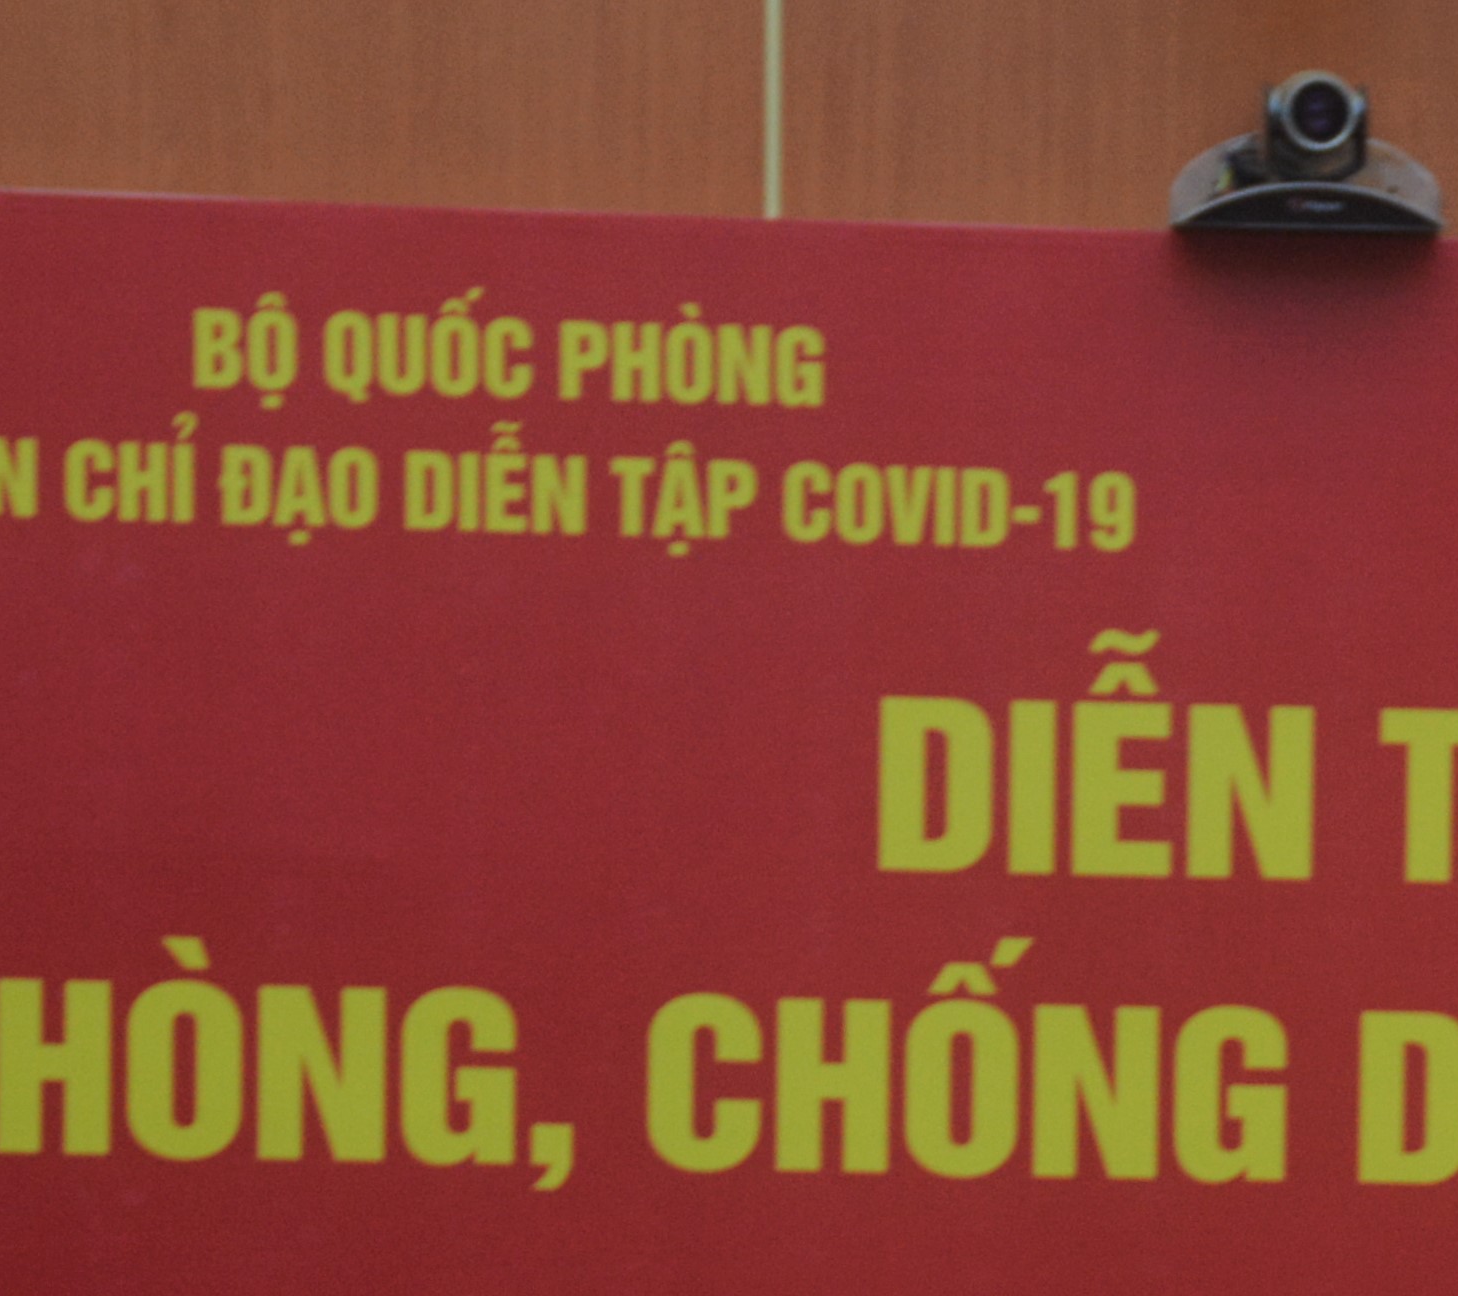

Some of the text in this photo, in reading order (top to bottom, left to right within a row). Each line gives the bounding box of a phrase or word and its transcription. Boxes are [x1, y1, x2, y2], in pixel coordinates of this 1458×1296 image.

[192, 287, 826, 410] BỘ QUỐC PHÒNG
[64, 412, 198, 524] CHỈ
[217, 443, 380, 547] ĐẠO
[403, 421, 588, 536] DIỄN
[609, 438, 759, 559] TẬP
[782, 459, 1137, 553] COVID-19
[877, 629, 1316, 882] DIỄN
[646, 937, 1289, 1185] CHỐNG
